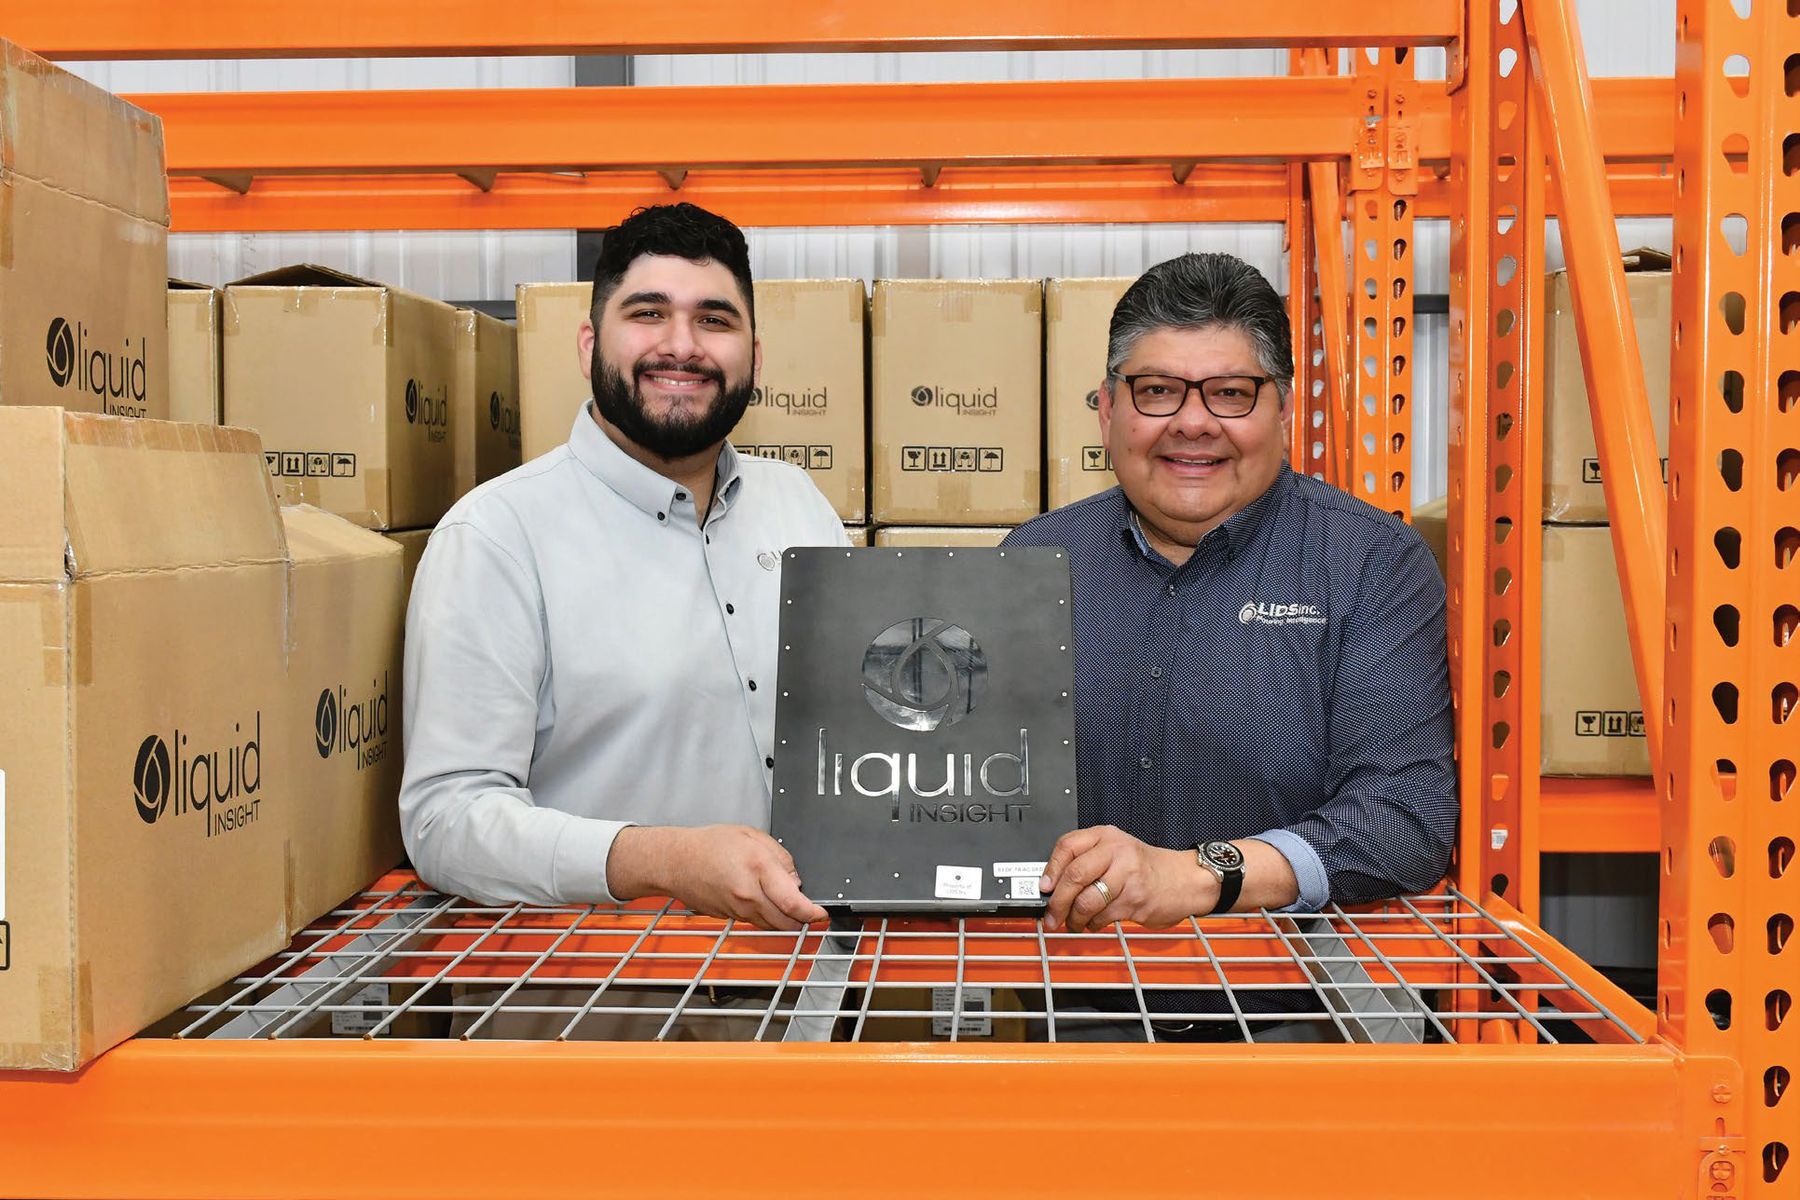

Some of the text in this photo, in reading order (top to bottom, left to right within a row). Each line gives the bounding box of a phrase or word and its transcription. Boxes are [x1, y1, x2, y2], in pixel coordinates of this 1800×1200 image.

[78, 321, 146, 414] liquid
[417, 380, 448, 441] liquid
[765, 385, 827, 415] liquid
[935, 385, 997, 415] liquid
[339, 669, 388, 771] liquid
[174, 710, 261, 837] liquid
[362, 741, 388, 770] INSIGHT
[817, 727, 1030, 823] liquid
[214, 799, 261, 836] INSIGHT
[909, 803, 1032, 823] INSIGHT
